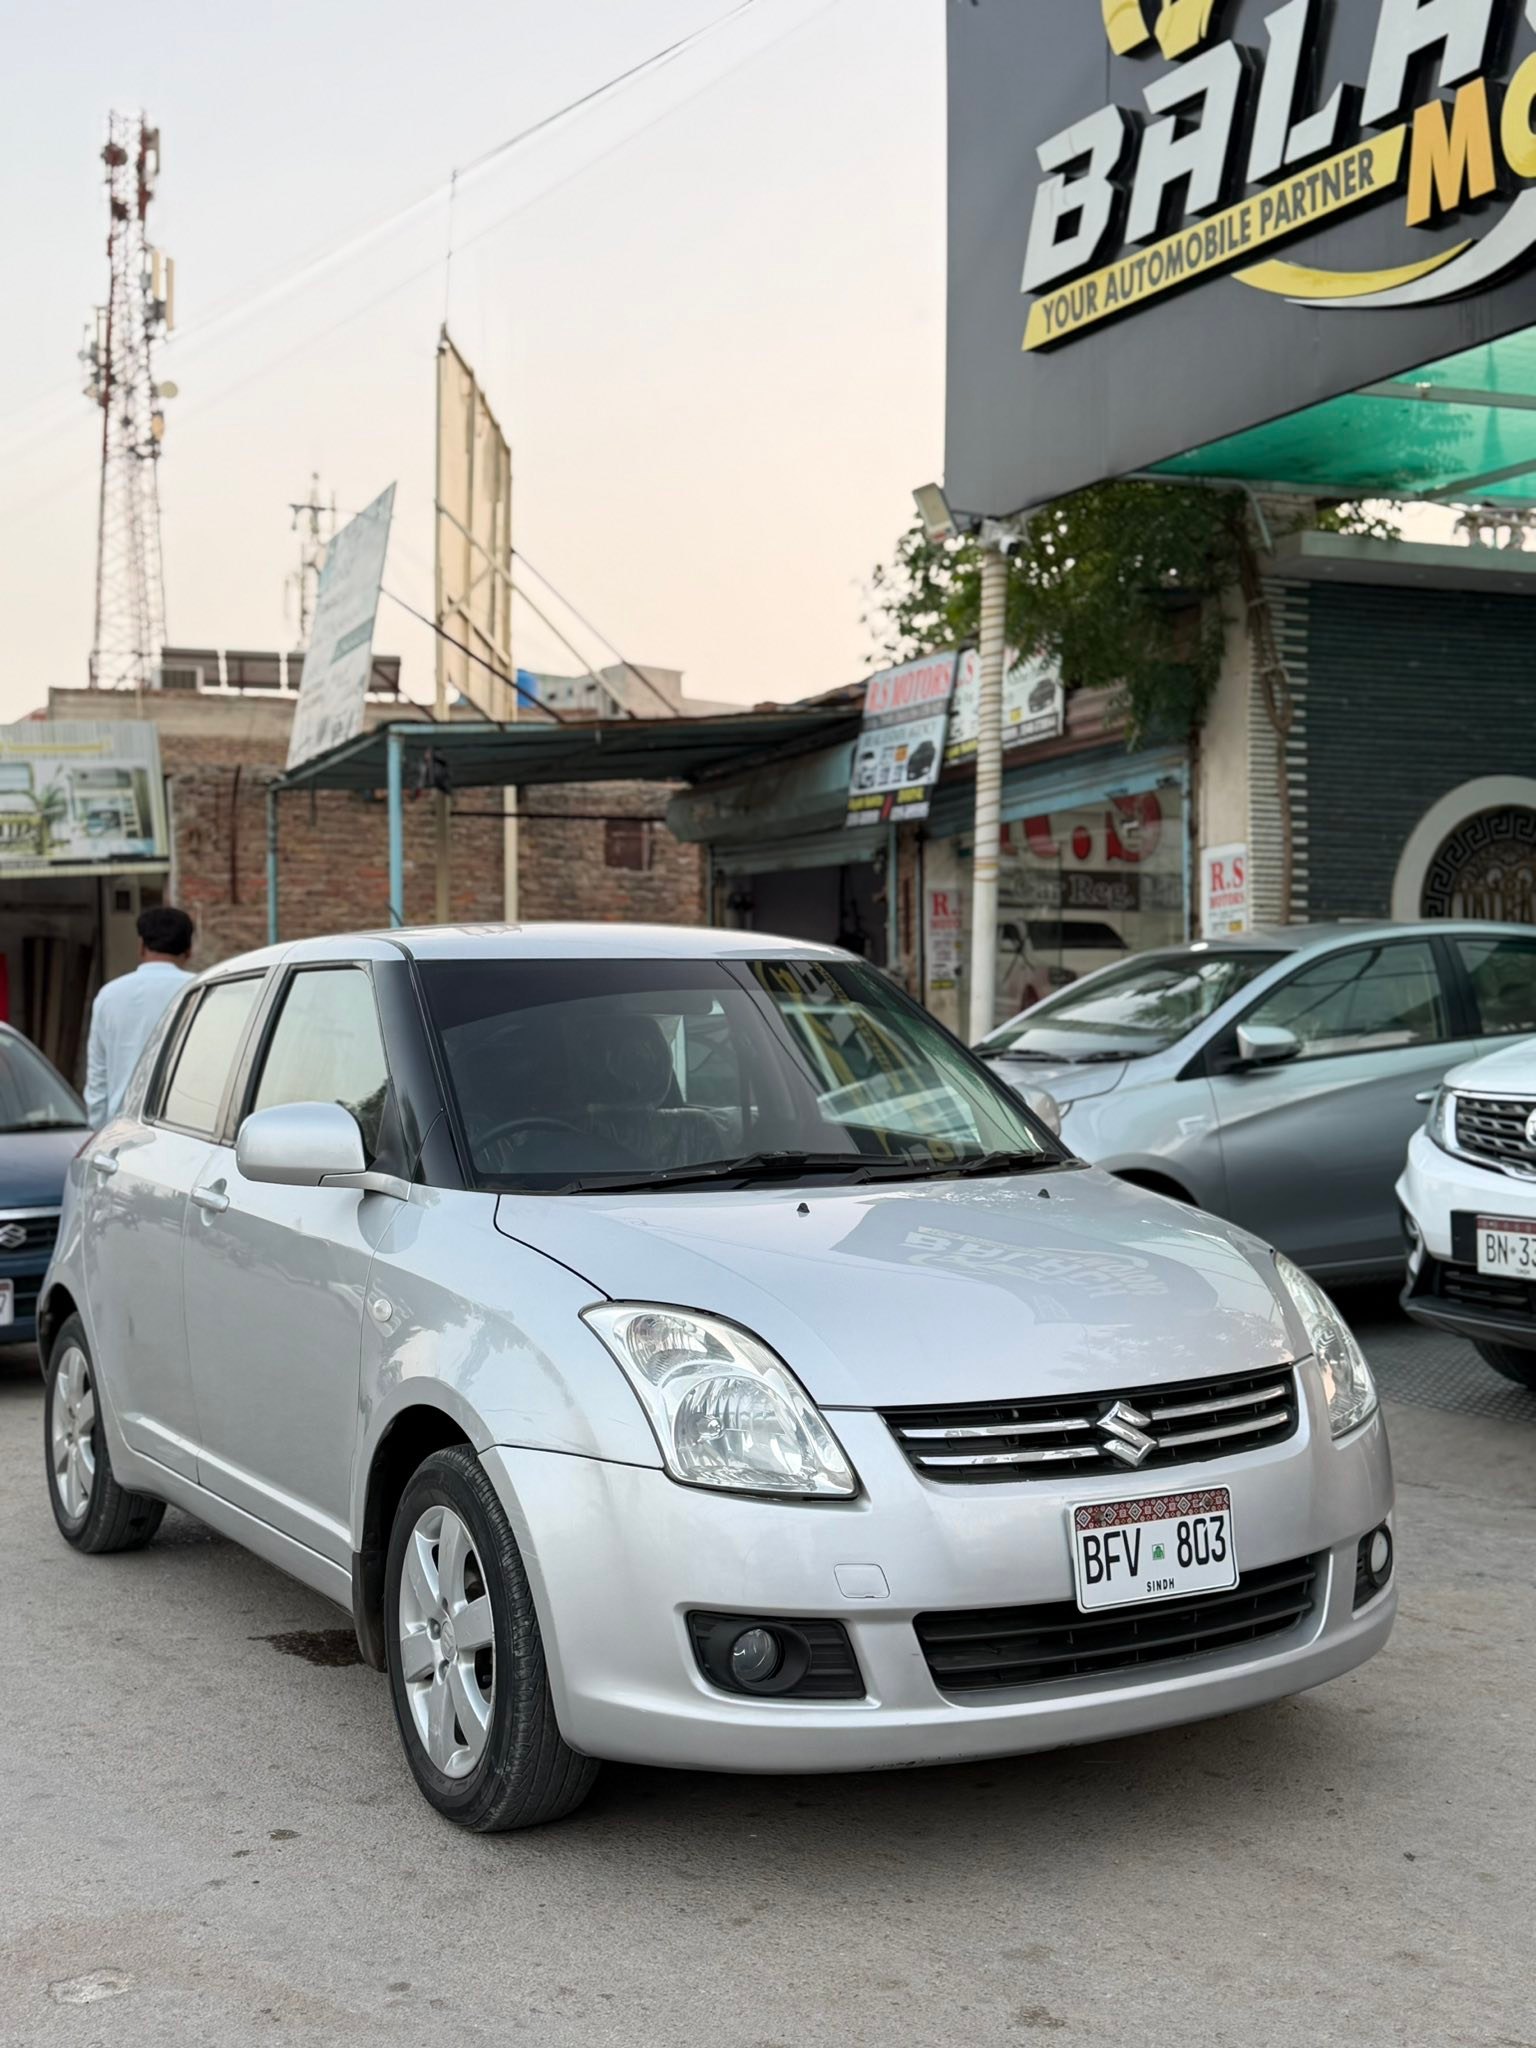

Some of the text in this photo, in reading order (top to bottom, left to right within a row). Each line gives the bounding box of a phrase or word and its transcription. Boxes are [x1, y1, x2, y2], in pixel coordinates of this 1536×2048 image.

[1021, 0, 1536, 293] BALA
[1043, 148, 1375, 334] YOUR AUTOMOBILE PARTNER
[892, 661, 954, 707] MOTORS
[1211, 857, 1244, 892] R.S
[1486, 1233, 1508, 1265] BN
[1083, 1515, 1226, 1584] BFV 803
[1146, 1578, 1175, 1592] SINDH
